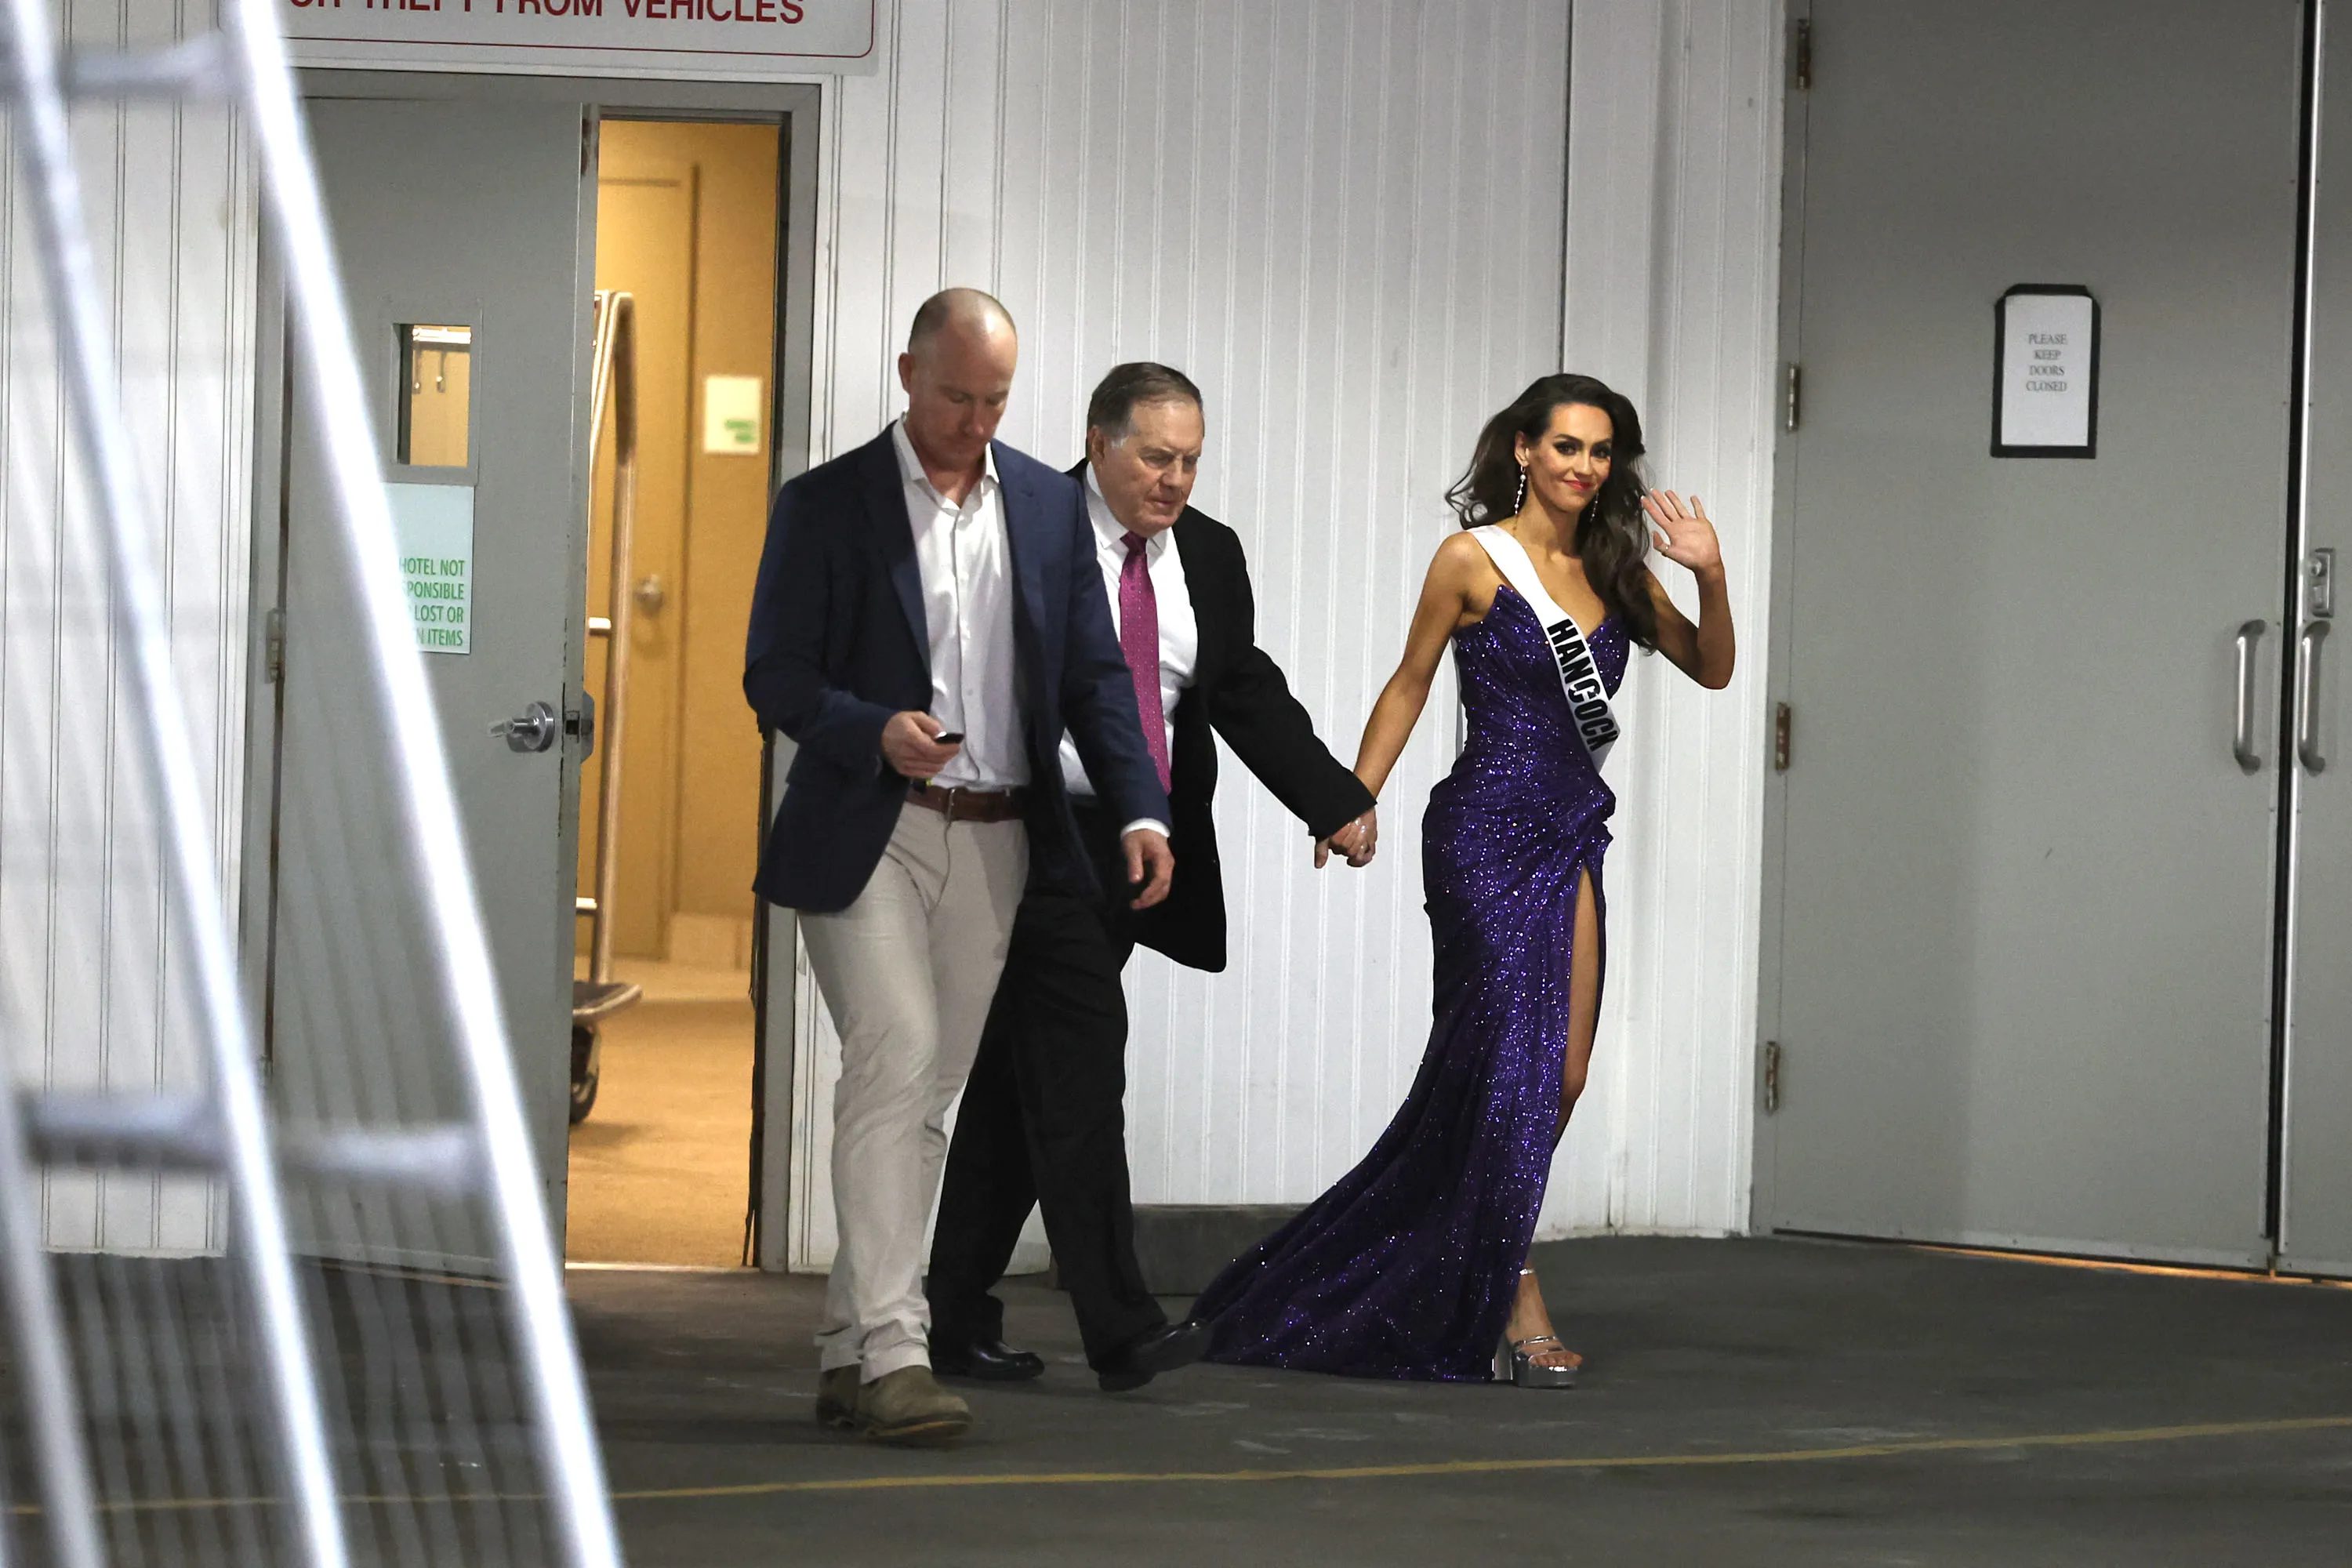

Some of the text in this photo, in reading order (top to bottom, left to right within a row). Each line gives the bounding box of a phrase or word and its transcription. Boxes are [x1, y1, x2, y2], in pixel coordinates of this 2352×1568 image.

[624, 0, 804, 24] VEHICLES
[2028, 333, 2067, 345] PLEASE
[2034, 350, 2061, 360] KEEP
[2029, 365, 2064, 376] DOORS
[2026, 381, 2067, 392] CLOSED
[398, 557, 465, 576] HOTEL NOT
[402, 580, 464, 600] PONSIBLE
[415, 604, 464, 623] LOST OR
[428, 628, 463, 647] ITEMS
[1547, 619, 1618, 752] HANCOCK
